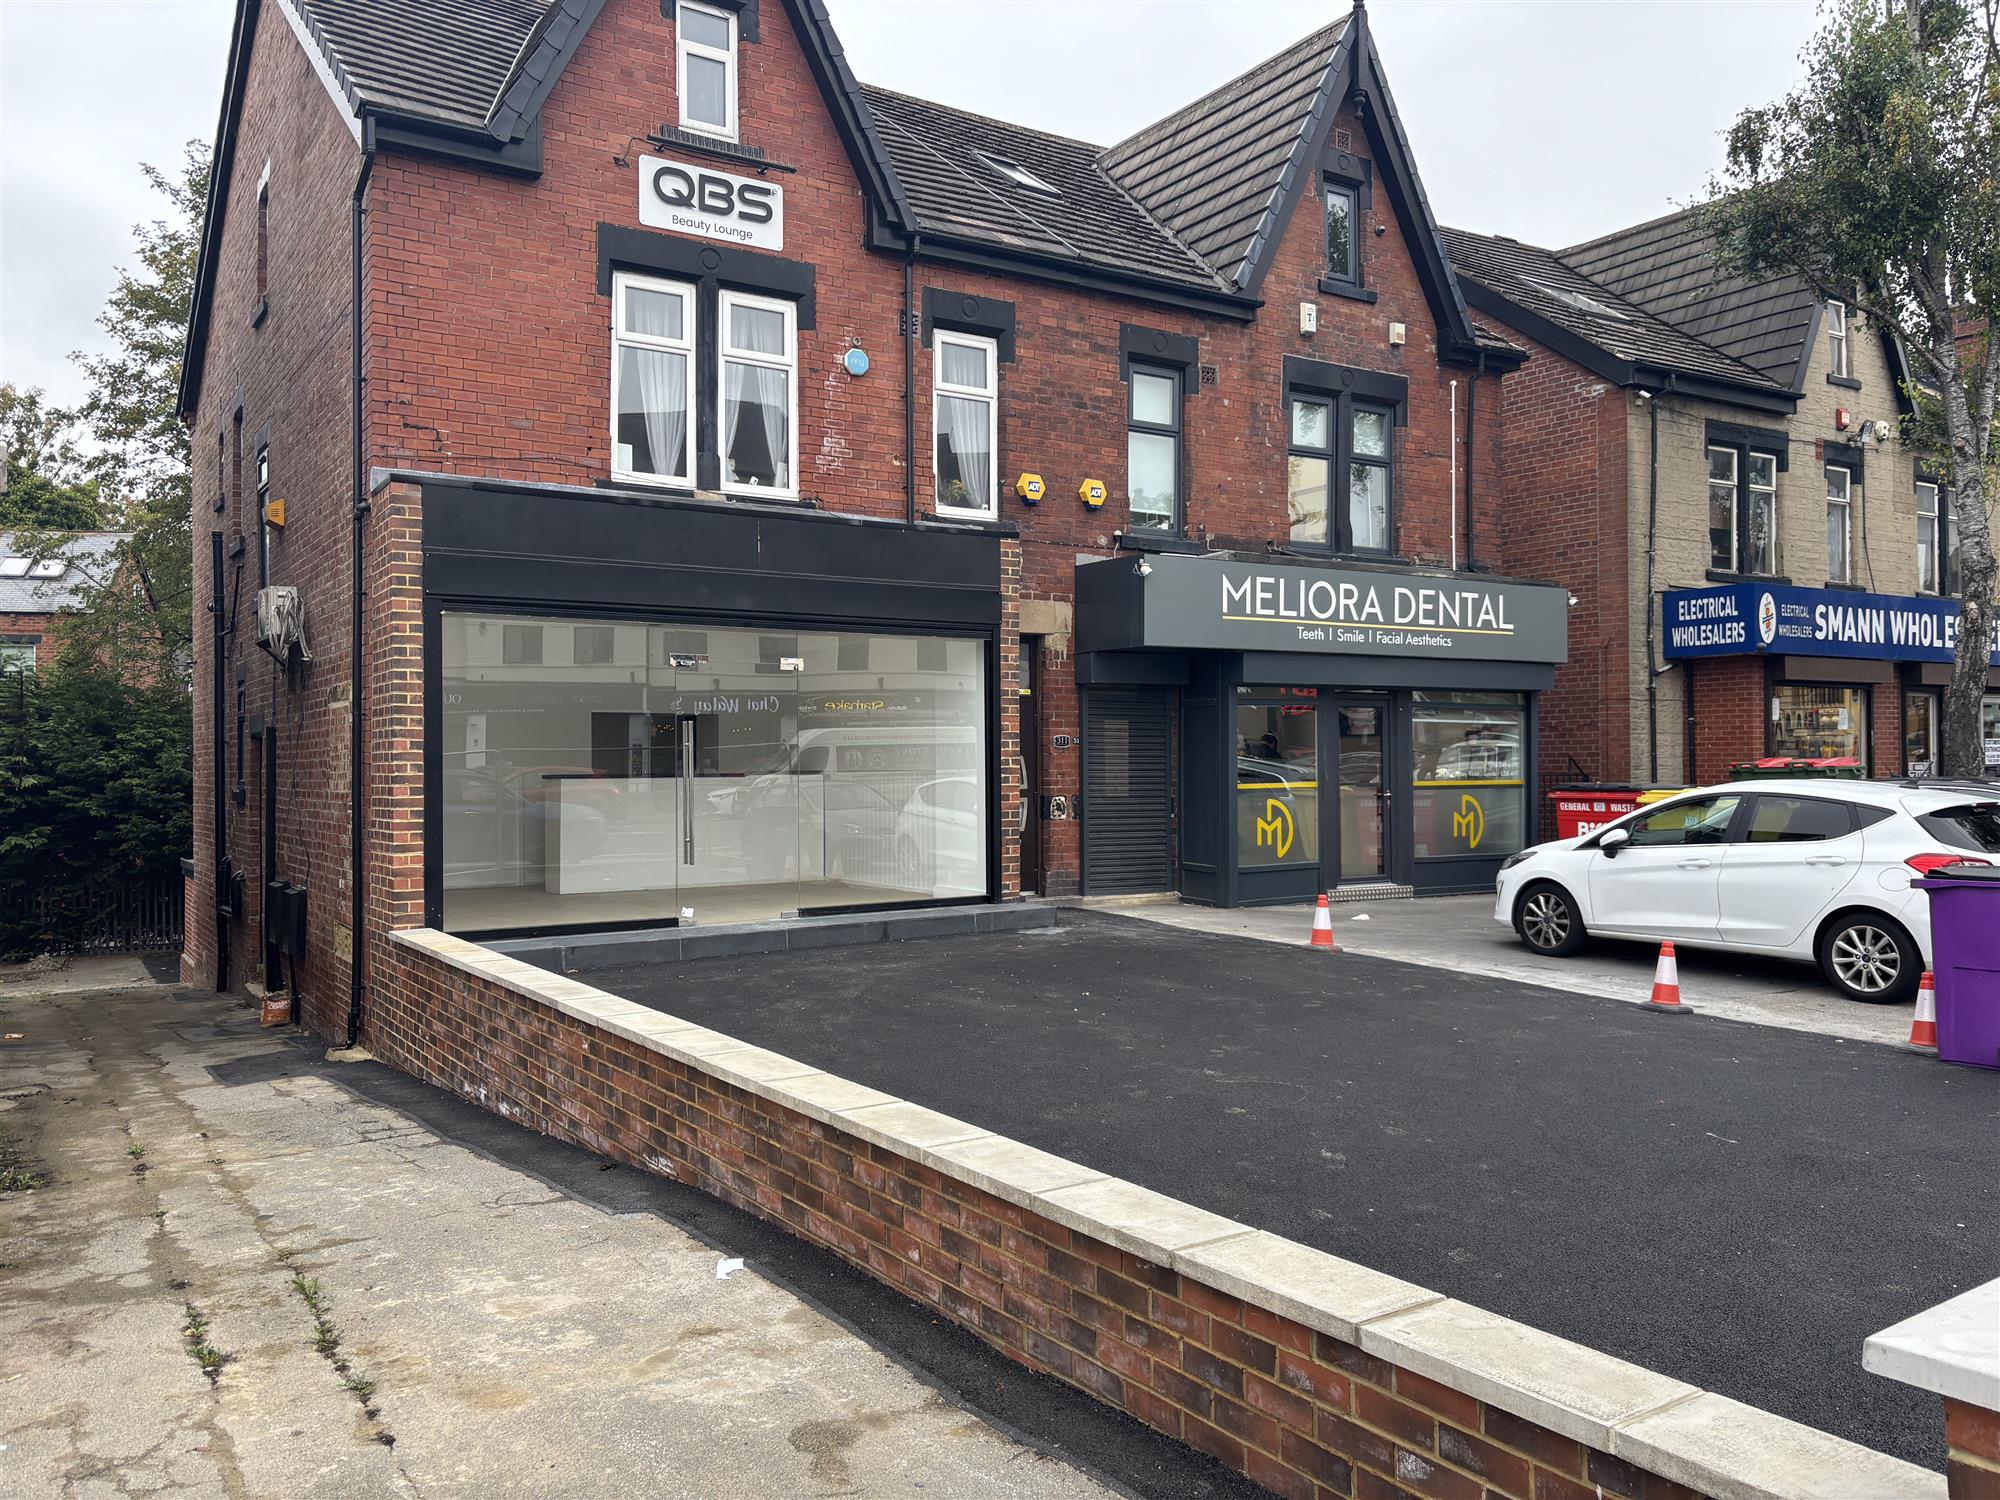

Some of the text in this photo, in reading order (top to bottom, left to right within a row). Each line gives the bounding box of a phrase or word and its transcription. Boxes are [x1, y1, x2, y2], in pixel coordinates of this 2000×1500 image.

[653, 166, 773, 223] QBS
[672, 214, 753, 241] Beauty Lounge
[1029, 482, 1040, 491] ADT
[1091, 488, 1102, 497] ADT
[1221, 573, 1514, 630] MELIORA DENTAL
[1678, 594, 1739, 622] ELECTRICAL
[1781, 603, 1810, 618] ELECTRICAL
[1671, 621, 1746, 648] WHOLESALERS
[1778, 623, 1813, 639] WHOLESALERS
[1814, 603, 1885, 645] SMANN
[1296, 626, 1452, 648] Teeth Smile Facial Aesthetics
[1560, 801, 1591, 812] GENERAL
